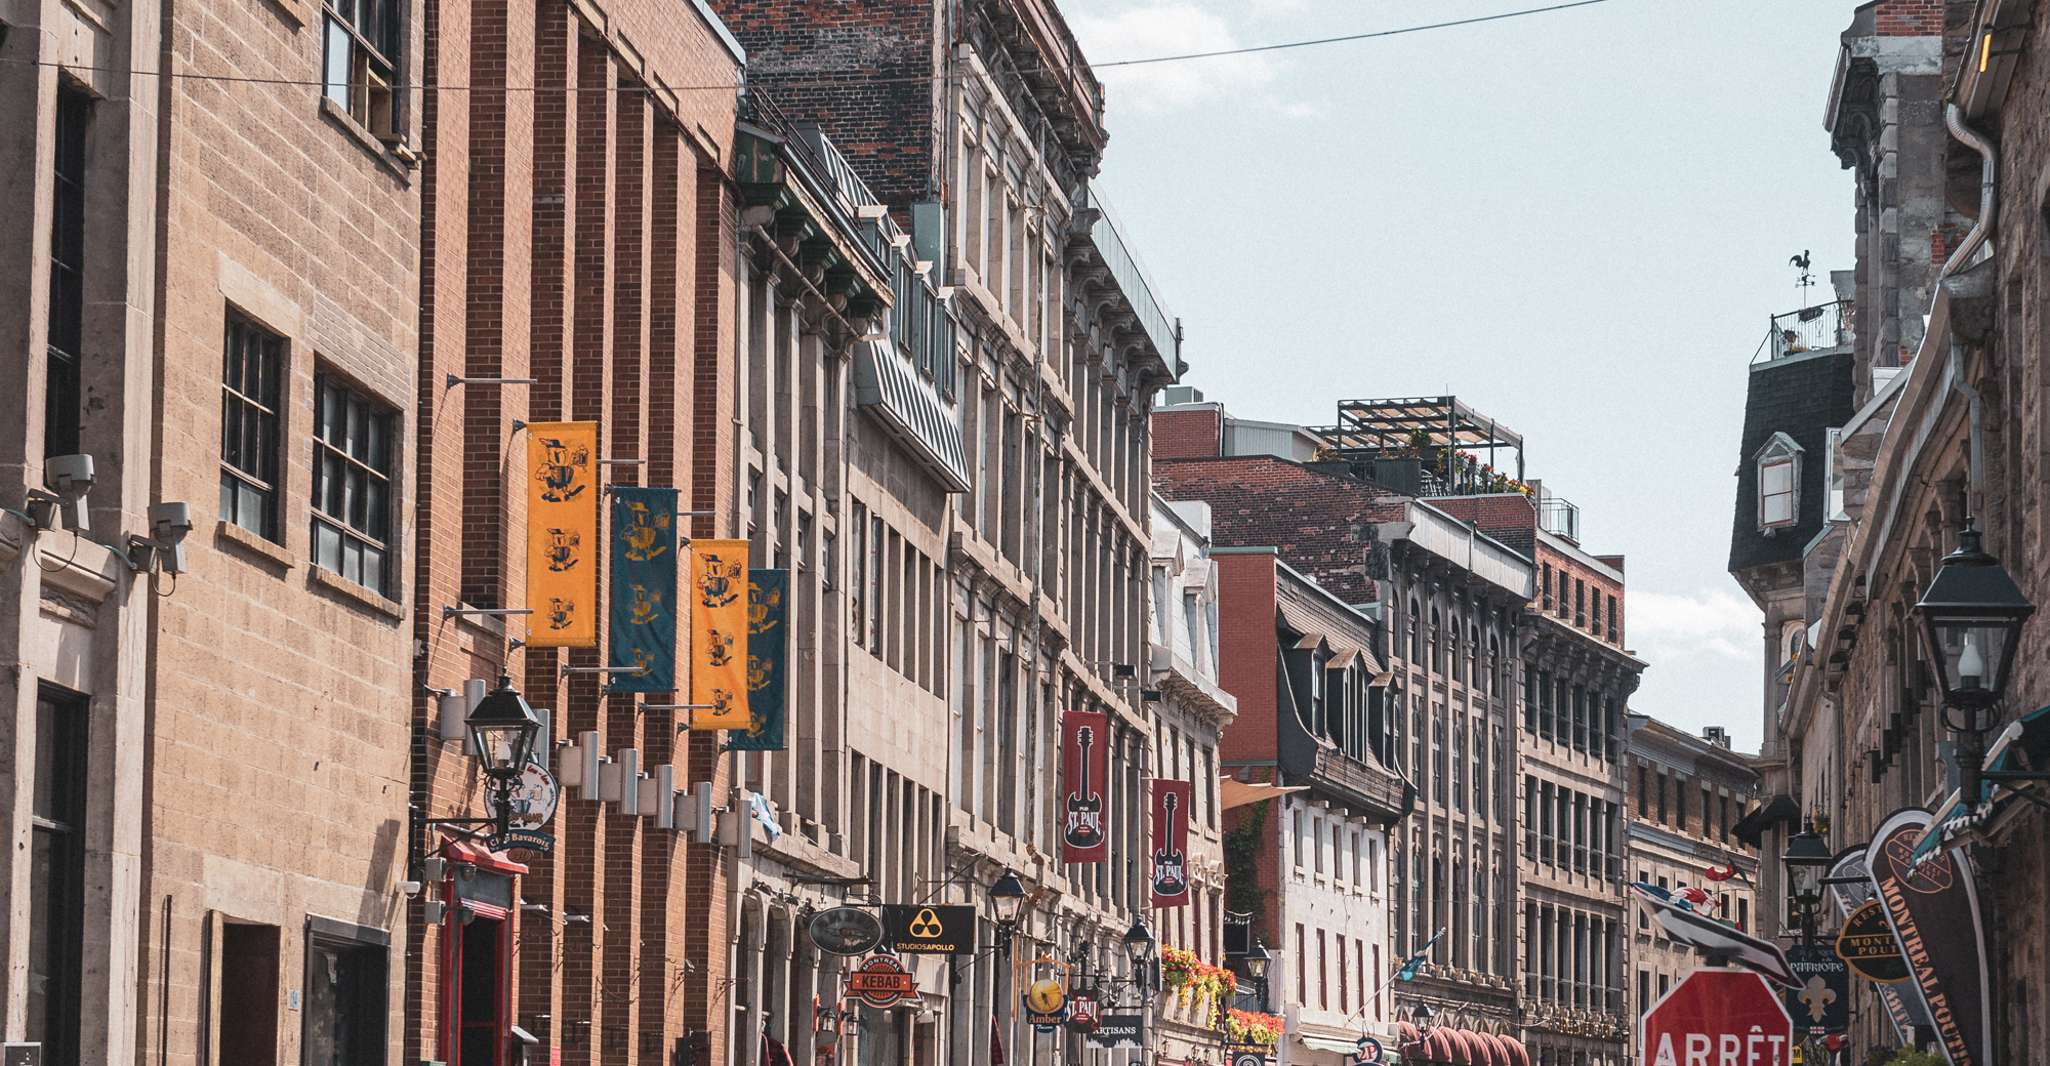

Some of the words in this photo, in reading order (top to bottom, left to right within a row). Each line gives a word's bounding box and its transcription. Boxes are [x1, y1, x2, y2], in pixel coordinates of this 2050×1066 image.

[1068, 811, 1079, 835] ST.
[1080, 812, 1101, 836] PAUL
[1165, 865, 1184, 886] PAUL
[1880, 876, 1938, 994] MONTREAL
[862, 975, 900, 989] KEBAB
[1030, 1014, 1062, 1024] Amber
[1653, 1025, 1785, 1066] ARRÊT
